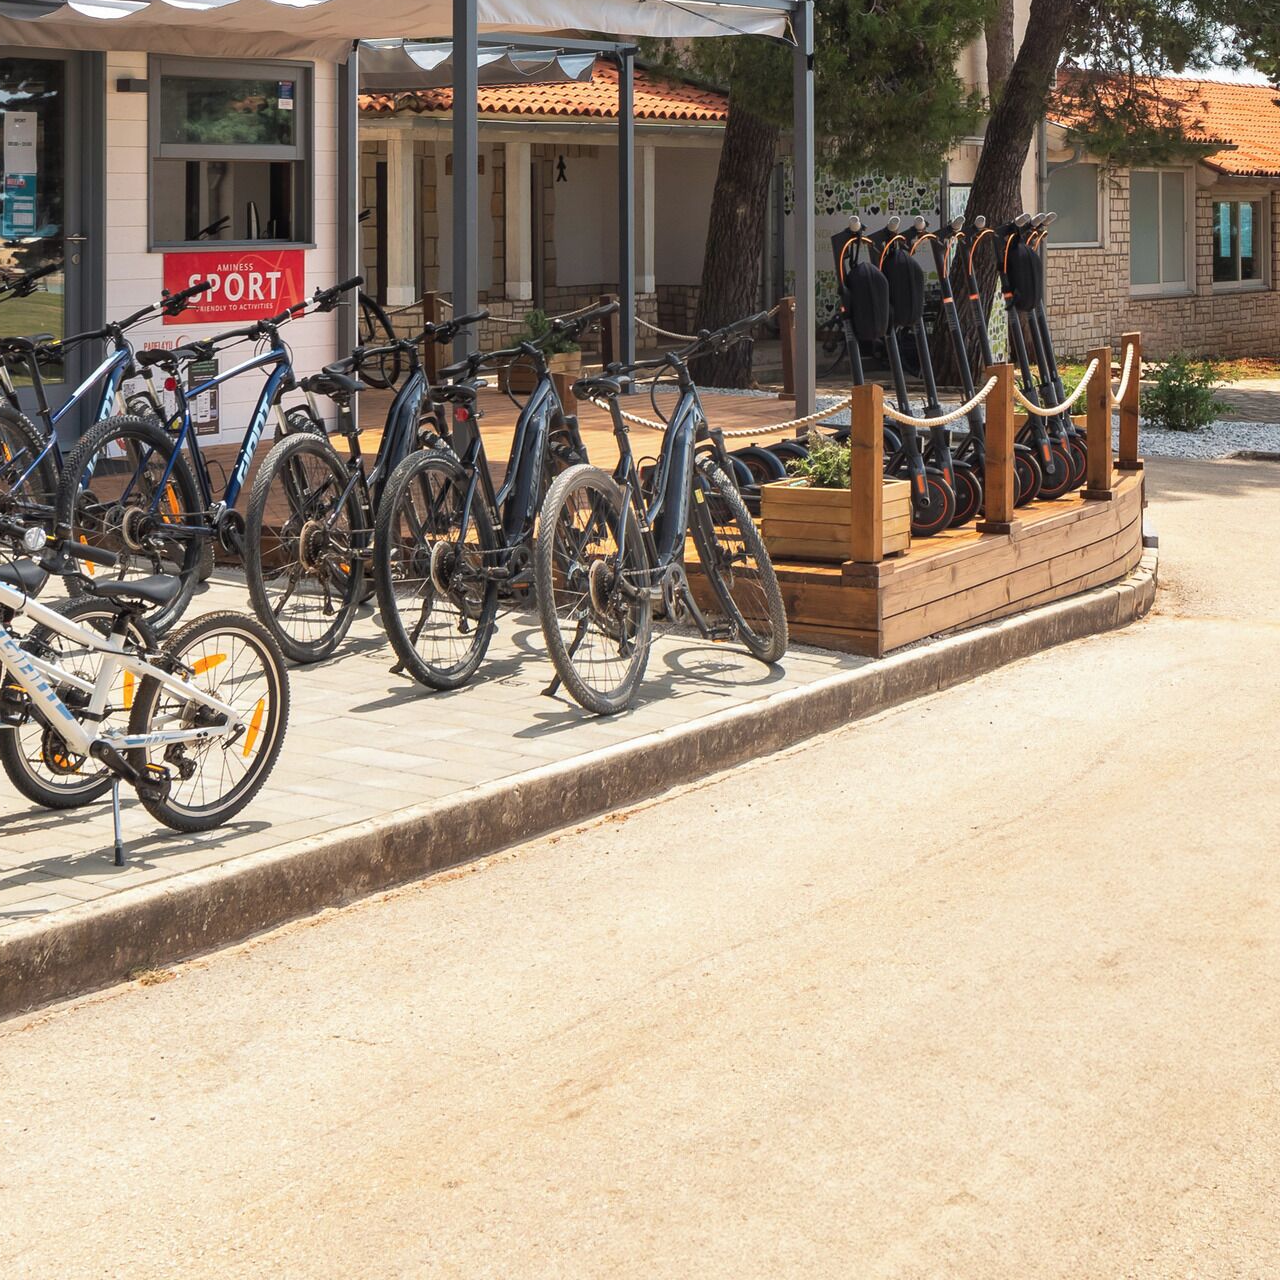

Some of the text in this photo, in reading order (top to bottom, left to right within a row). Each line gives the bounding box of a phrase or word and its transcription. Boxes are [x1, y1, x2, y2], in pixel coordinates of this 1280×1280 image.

[216, 263, 254, 272] AMINESS
[188, 272, 282, 303] SPORT
[229, 303, 237, 311] TO
[239, 302, 273, 311] ACTIVITIES
